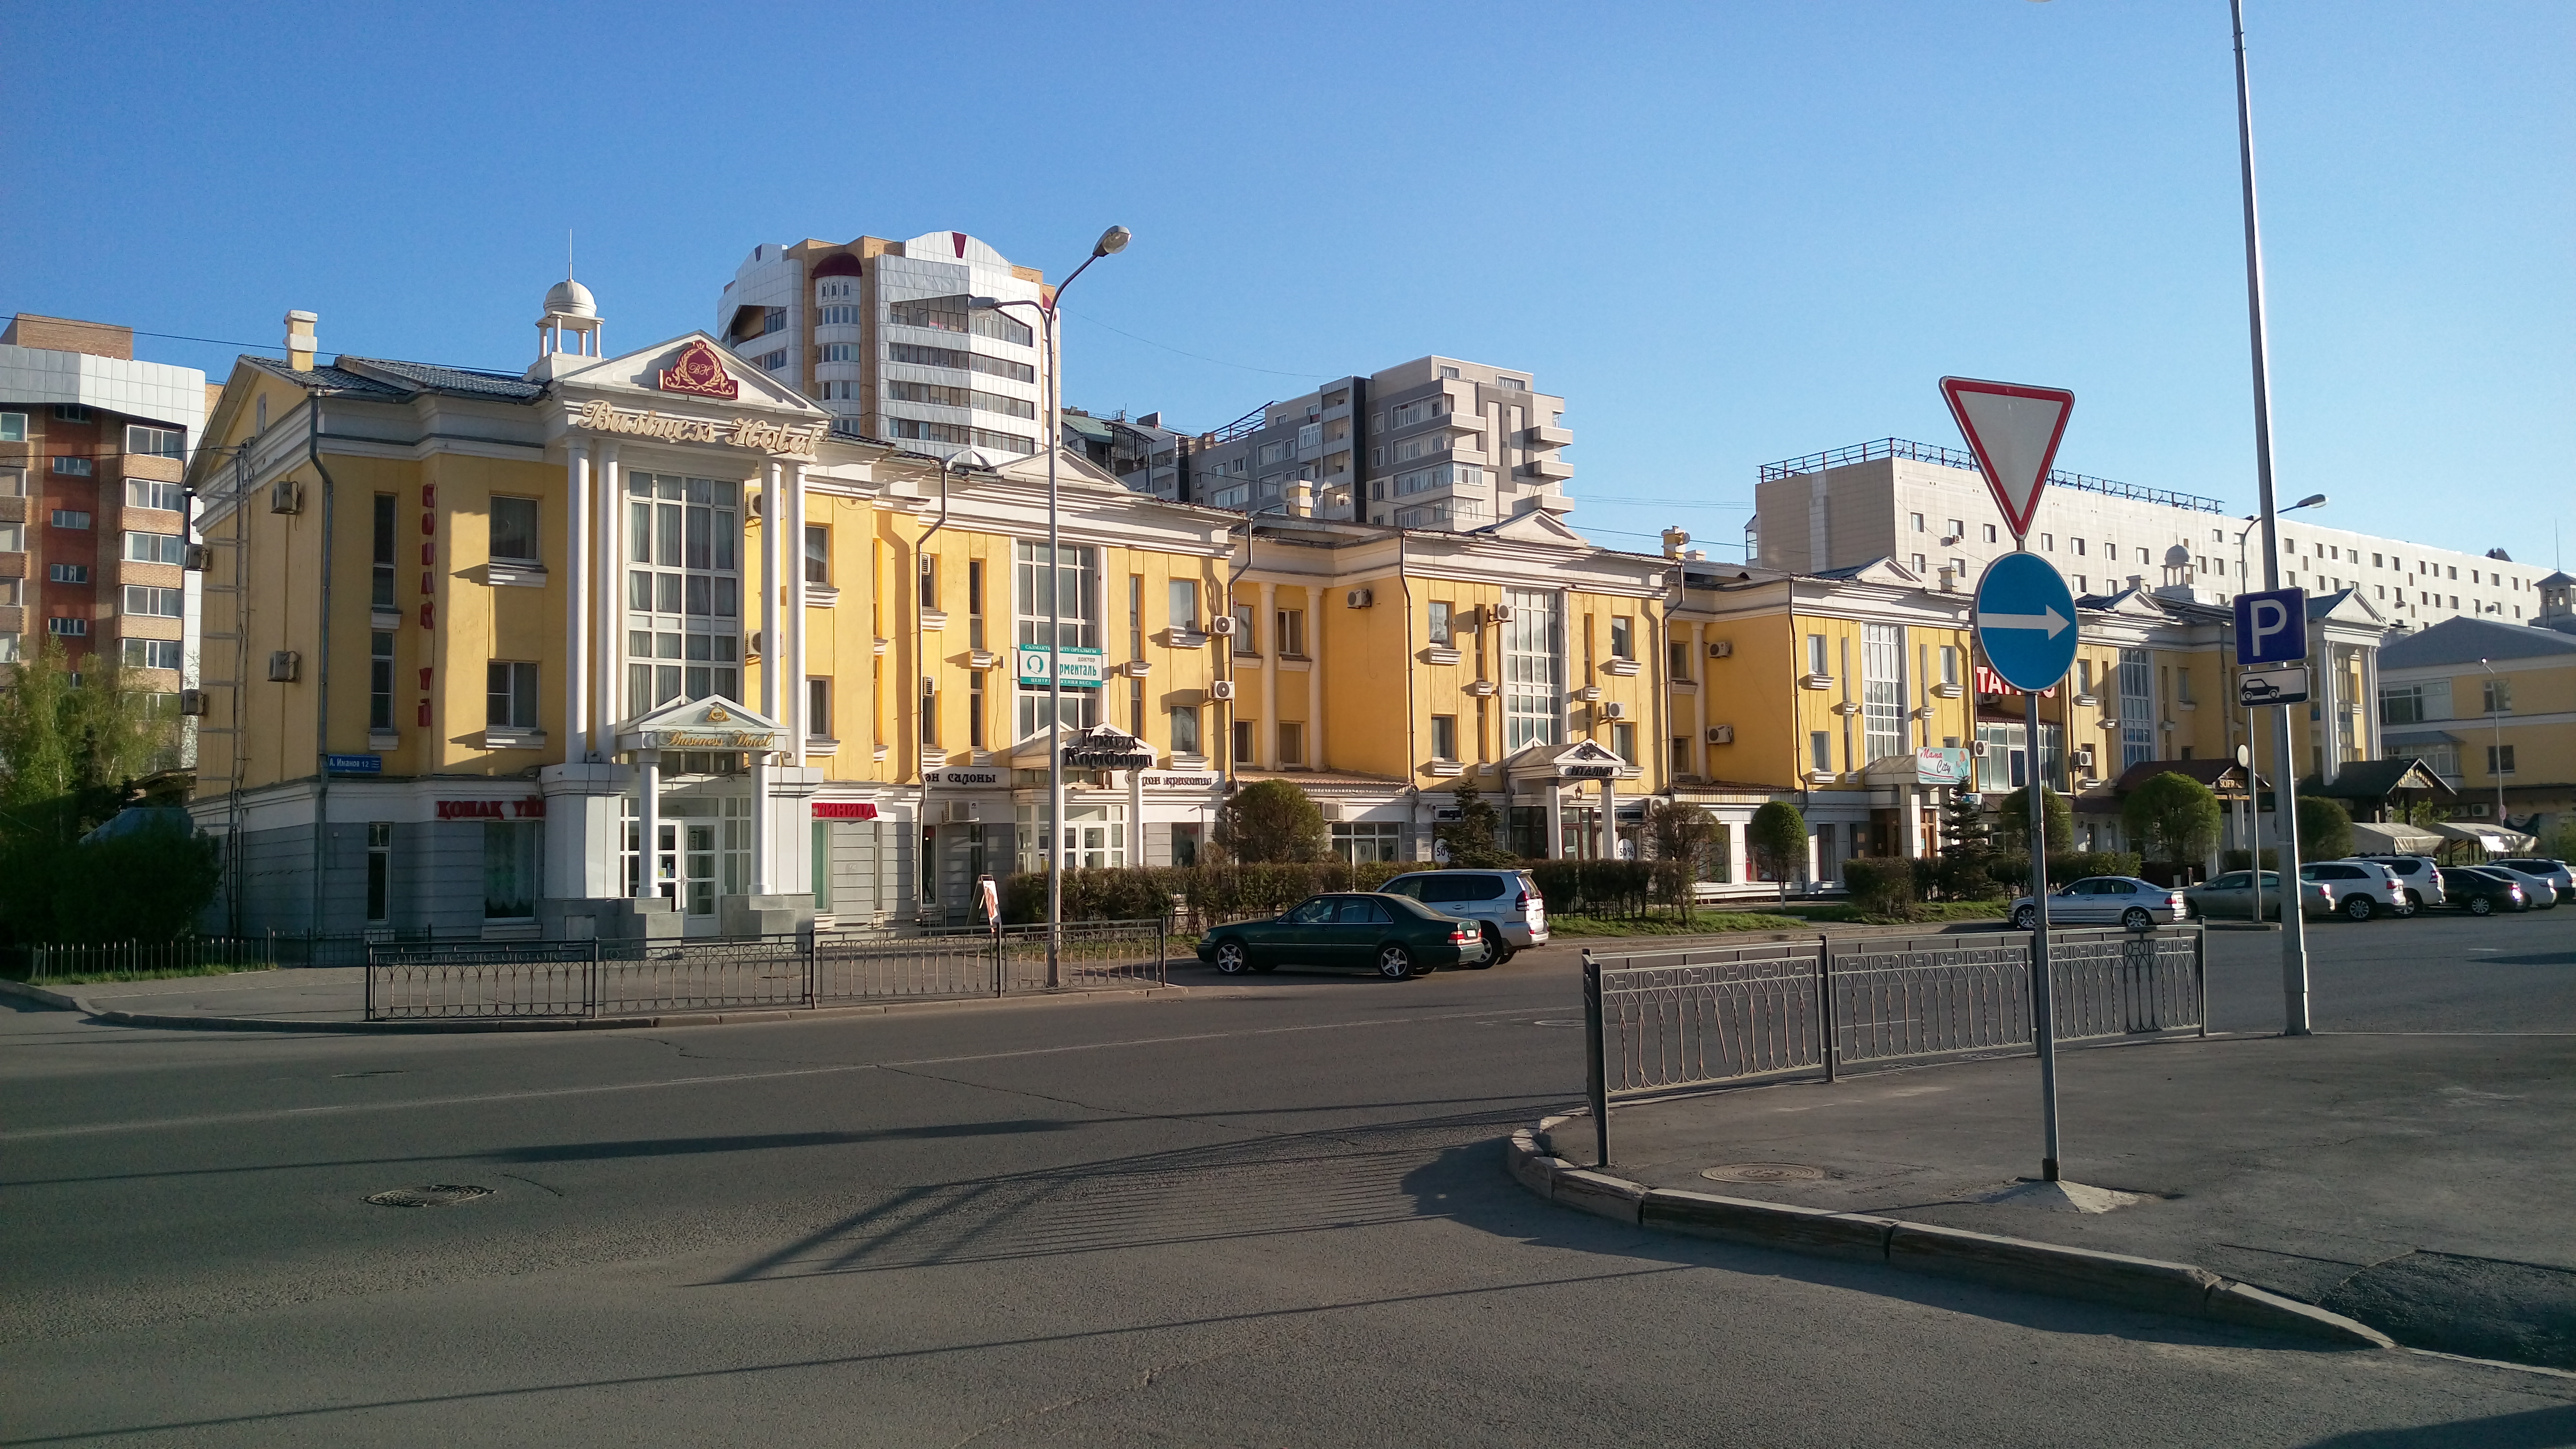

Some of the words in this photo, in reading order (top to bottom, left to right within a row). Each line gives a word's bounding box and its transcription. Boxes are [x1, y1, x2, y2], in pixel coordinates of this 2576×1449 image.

[577, 399, 717, 443] Business
[724, 417, 820, 456] Hotel
[2250, 599, 2287, 656] P
[1049, 661, 1097, 676] рменталь
[659, 729, 725, 747] Business
[727, 729, 774, 747] Hotel
[1937, 759, 1951, 774] City
[948, 773, 996, 785] салоны
[1619, 847, 1634, 857] 50%
